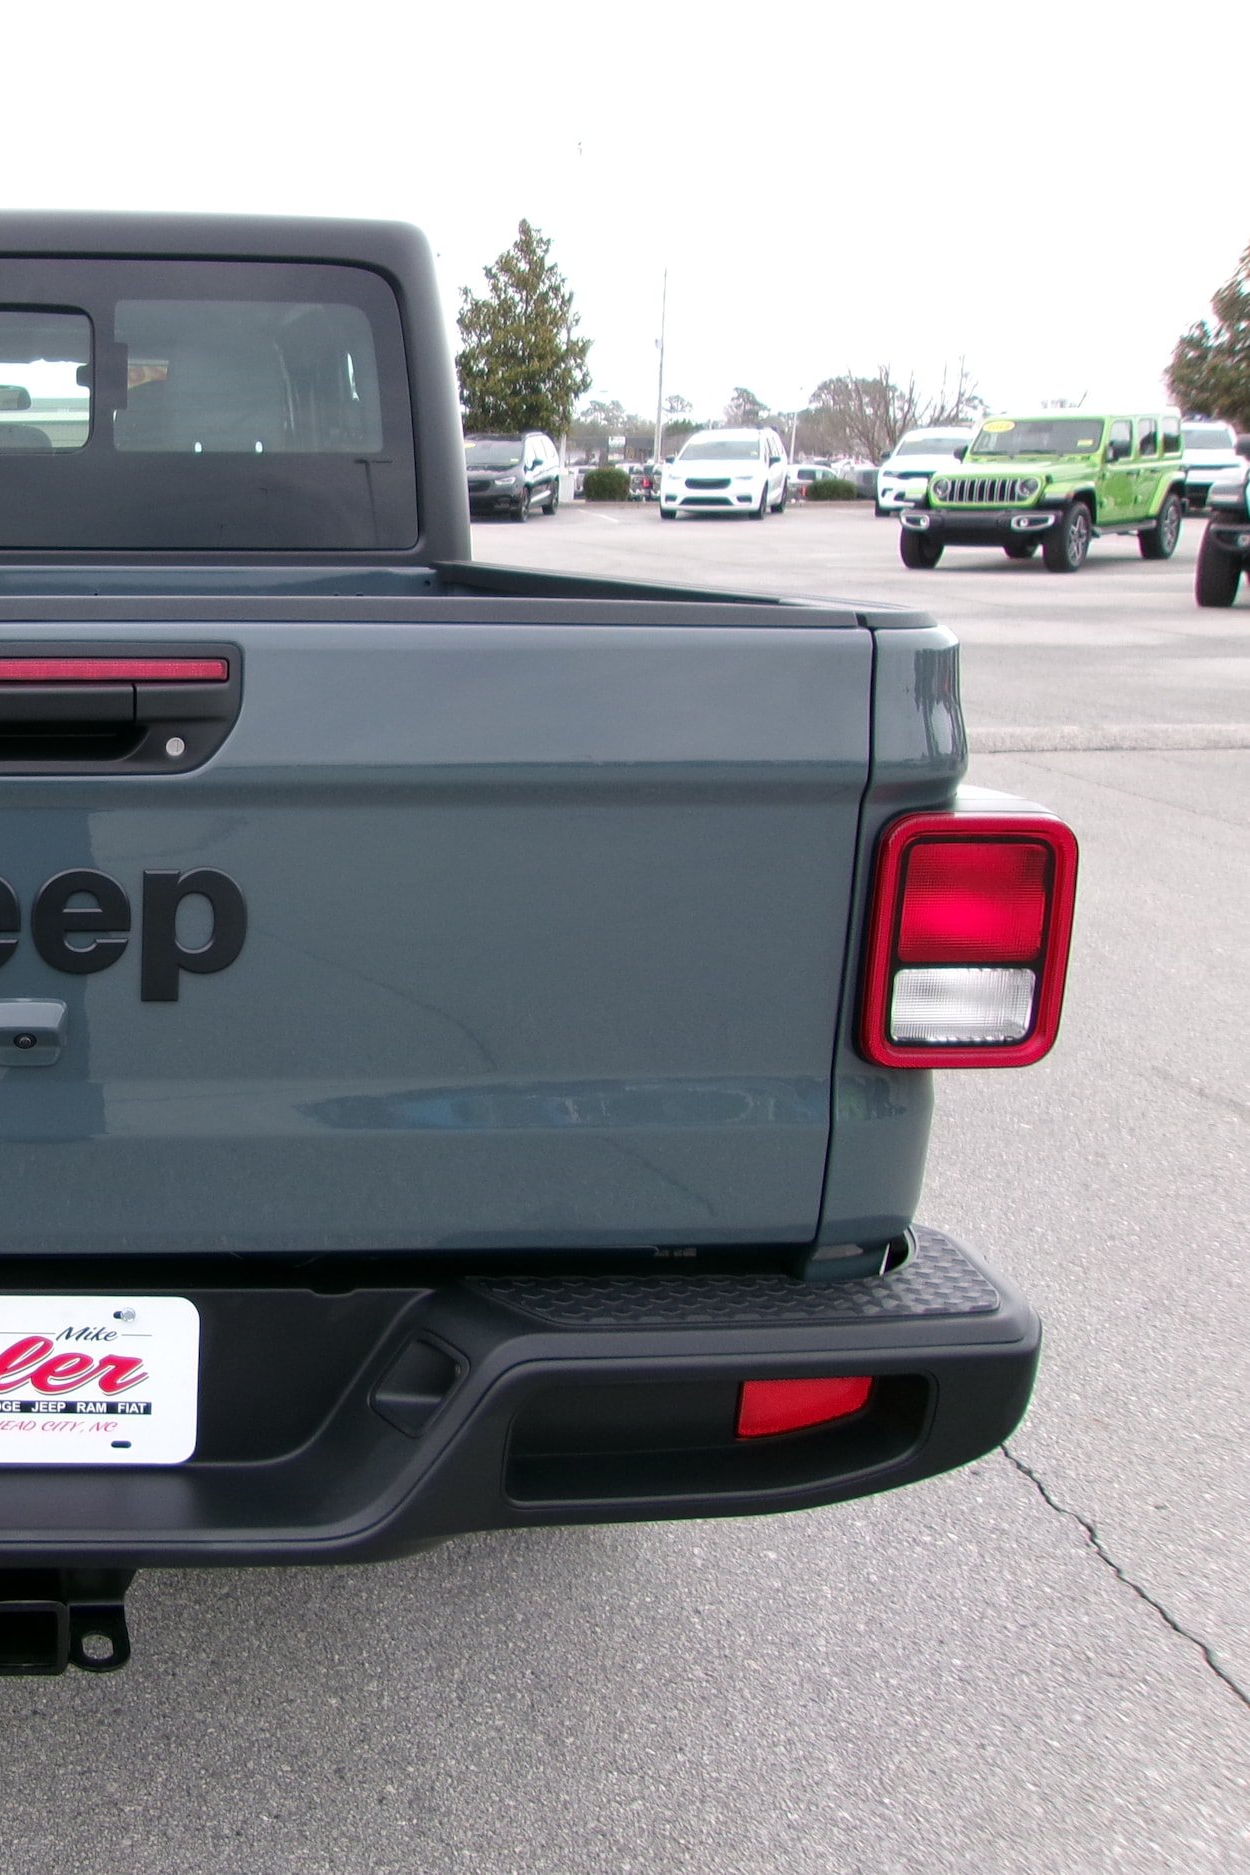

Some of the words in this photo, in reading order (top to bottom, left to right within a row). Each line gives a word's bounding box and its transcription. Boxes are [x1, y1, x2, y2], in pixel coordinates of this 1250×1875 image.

[56, 1326, 118, 1342] Mike
[31, 1401, 66, 1413] JEEP
[76, 1402, 107, 1413] RAM
[117, 1402, 147, 1414] FIAT
[89, 1421, 119, 1433] NC
